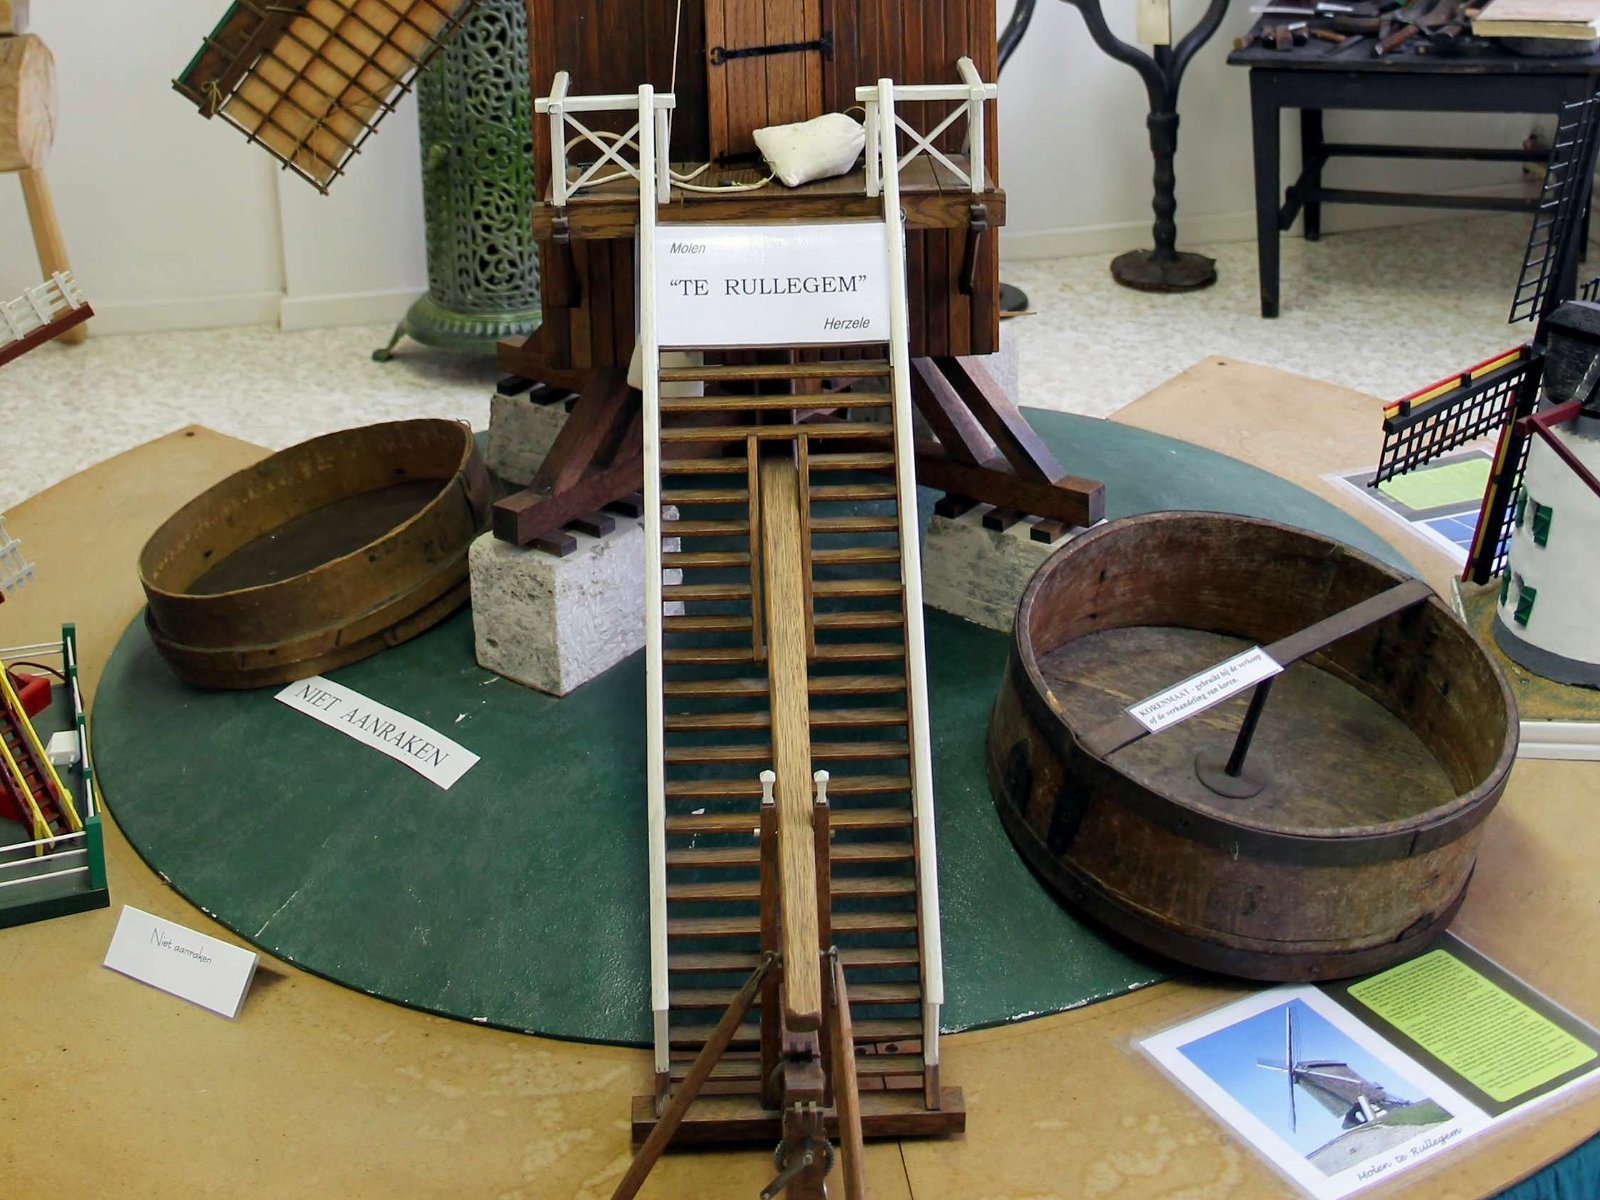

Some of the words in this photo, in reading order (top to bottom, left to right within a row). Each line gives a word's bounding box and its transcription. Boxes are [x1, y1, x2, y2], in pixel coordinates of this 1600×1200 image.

[669, 242, 706, 254] Molen
[823, 316, 870, 330] Herzele
[1140, 688, 1192, 717] KORENMAAT
[1194, 672, 1221, 691] gebruikt
[1220, 667, 1231, 679] bij
[1229, 662, 1238, 673] de
[1237, 653, 1262, 670] verkoop
[295, 684, 342, 712] NIET
[340, 707, 450, 768] AANRAKEN
[1149, 715, 1158, 726] of
[1157, 711, 1166, 721] de
[1166, 692, 1207, 716] verhandeling
[1207, 686, 1219, 697] van
[150, 927, 174, 949] Niet
[173, 945, 212, 965] aanraken
[1358, 1160, 1393, 1182] Molen
[1395, 1154, 1408, 1163] te
[1410, 1127, 1462, 1157] Rullegem
